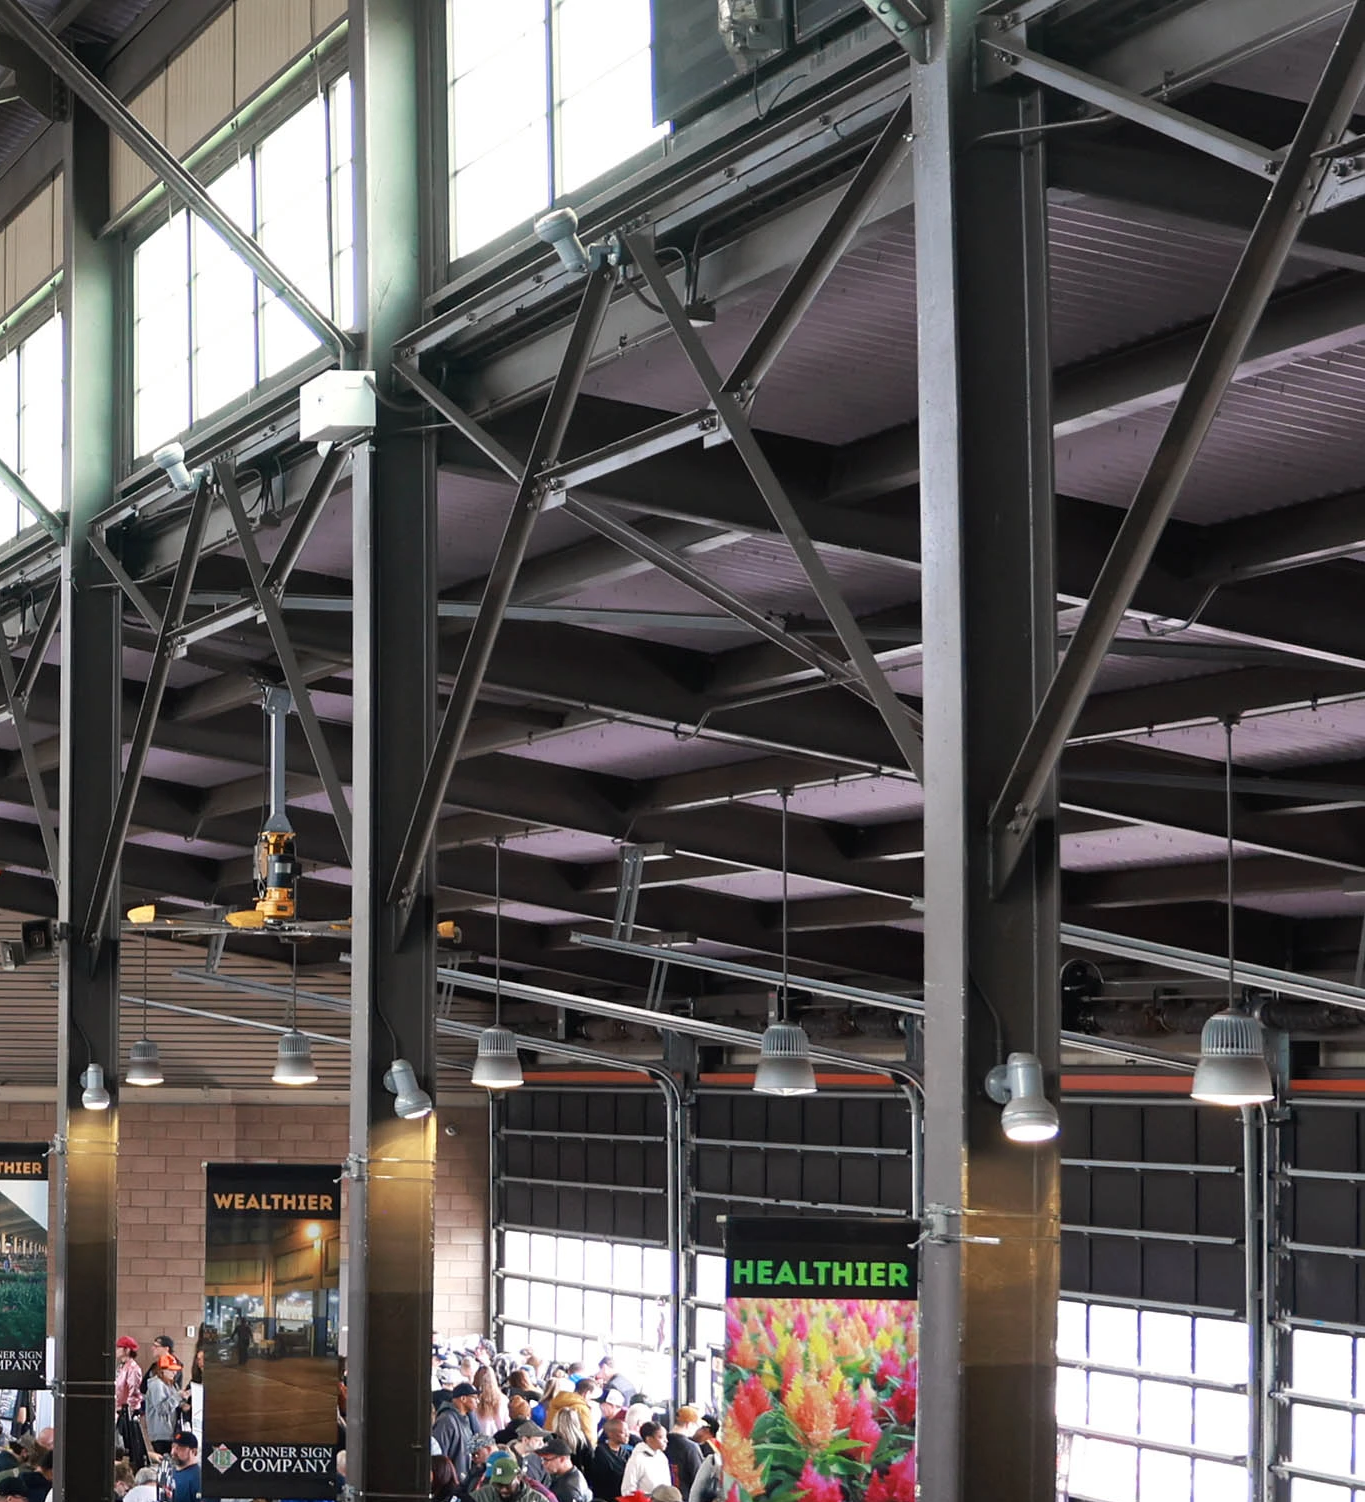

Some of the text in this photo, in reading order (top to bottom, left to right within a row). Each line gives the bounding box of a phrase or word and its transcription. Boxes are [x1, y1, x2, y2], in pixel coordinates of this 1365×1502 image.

[213, 1192, 333, 1212] WEALTHIER
[733, 1260, 909, 1288] HEALTHIER
[18, 1351, 43, 1360] SIGN
[241, 1446, 333, 1459] BANNER SIGN
[240, 1458, 331, 1473] COMPANY
